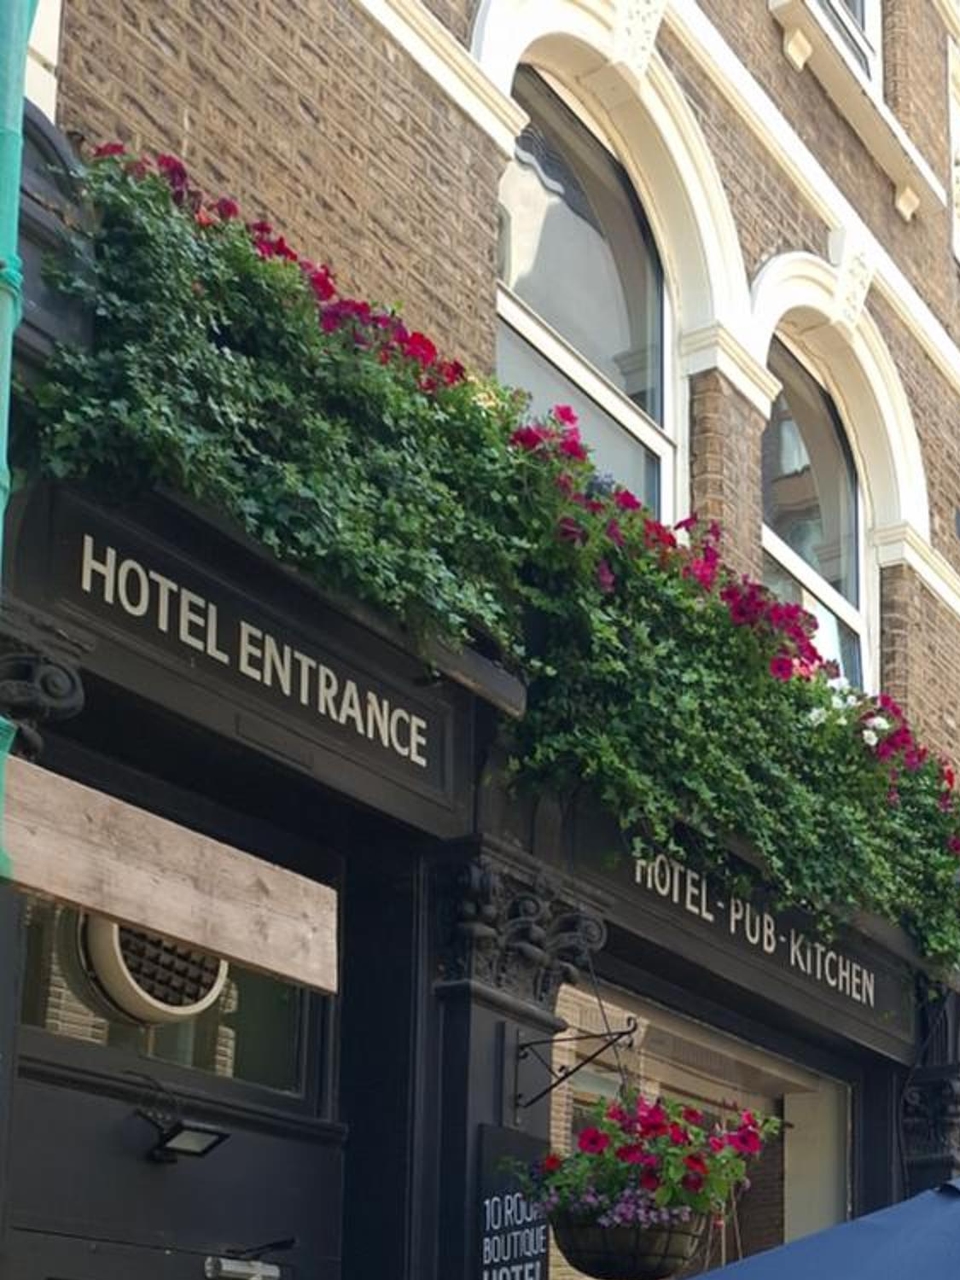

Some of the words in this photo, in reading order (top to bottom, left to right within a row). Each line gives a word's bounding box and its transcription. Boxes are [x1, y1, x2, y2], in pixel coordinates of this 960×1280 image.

[82, 534, 229, 665] HOTEL
[239, 620, 428, 768] ENTRANCE
[635, 854, 715, 923] HOTEL
[729, 897, 777, 955] PUB
[790, 928, 875, 1008] KITCHEN
[483, 1225, 546, 1265] BOUTIQUE
[484, 1196, 501, 1231] 10
